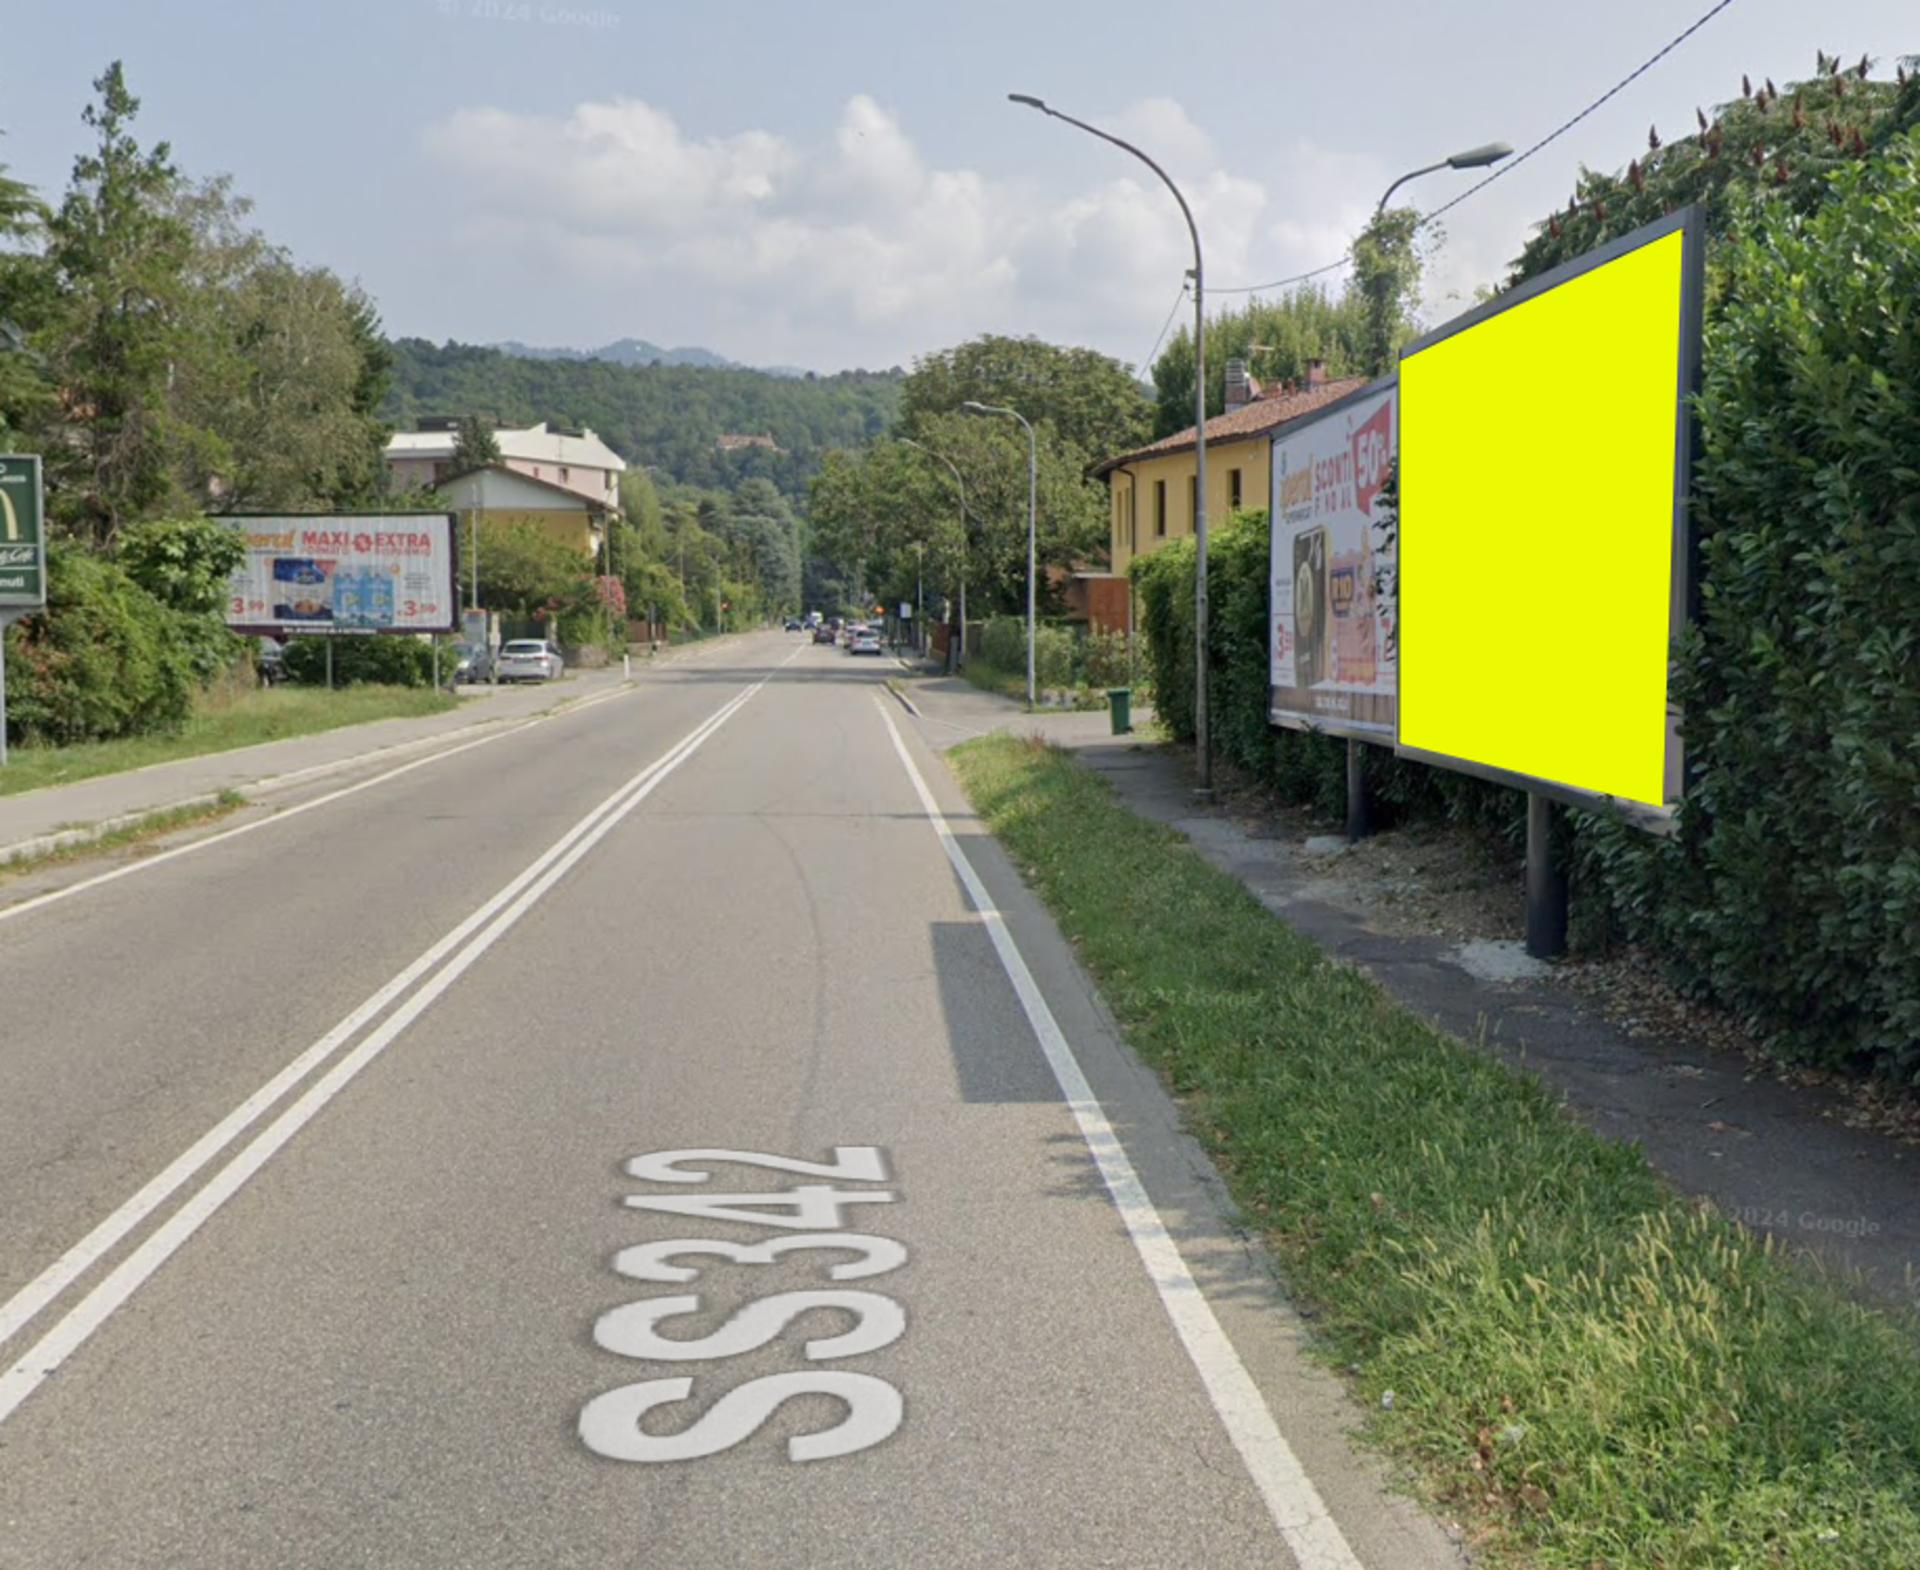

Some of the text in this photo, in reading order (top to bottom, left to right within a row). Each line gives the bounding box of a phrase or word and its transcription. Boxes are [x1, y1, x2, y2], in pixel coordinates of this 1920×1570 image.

[1315, 449, 1351, 494] SCONTI
[302, 531, 349, 547] MAXI
[375, 533, 432, 548] EXTRA
[578, 1146, 908, 1463] SS342
